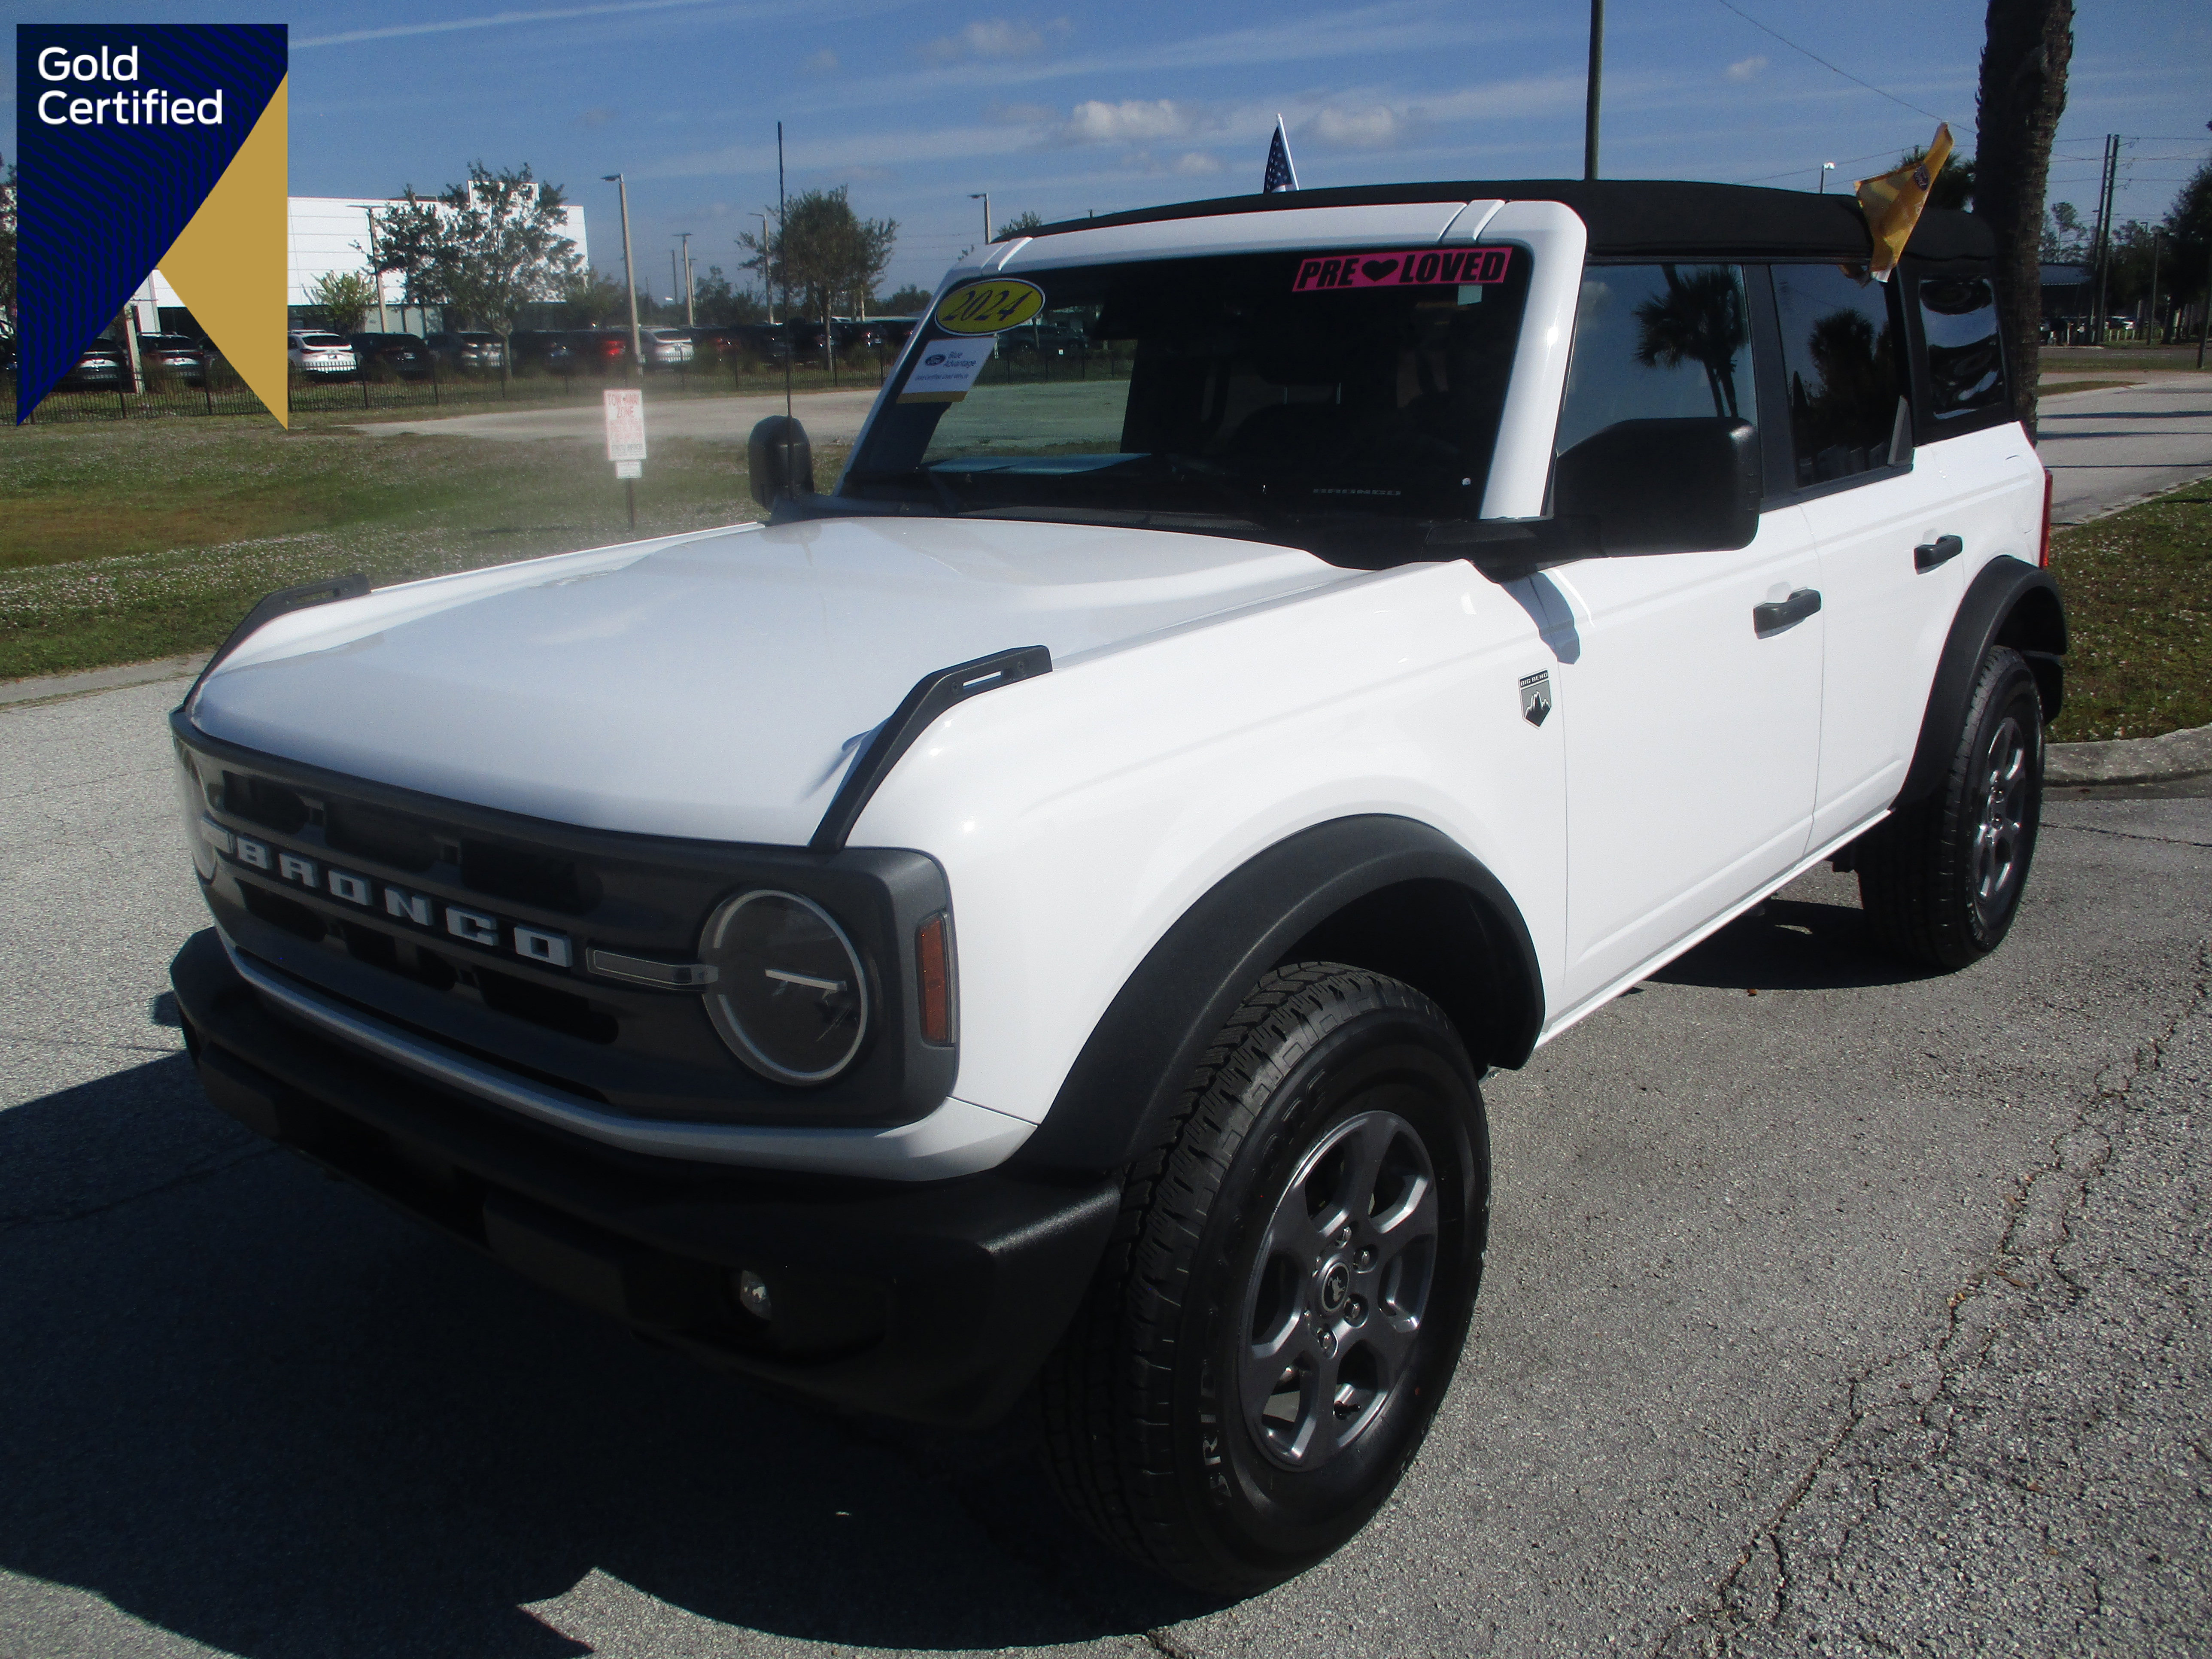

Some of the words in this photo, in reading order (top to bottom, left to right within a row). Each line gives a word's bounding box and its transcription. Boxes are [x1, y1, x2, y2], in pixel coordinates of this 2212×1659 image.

[1296, 258, 1360, 289] PRE
[1399, 251, 1506, 283] LOVED
[942, 289, 1033, 321] 2024
[943, 359, 977, 368] Advantage
[1532, 673, 1548, 682] BEND
[237, 836, 574, 969] BRONCO
